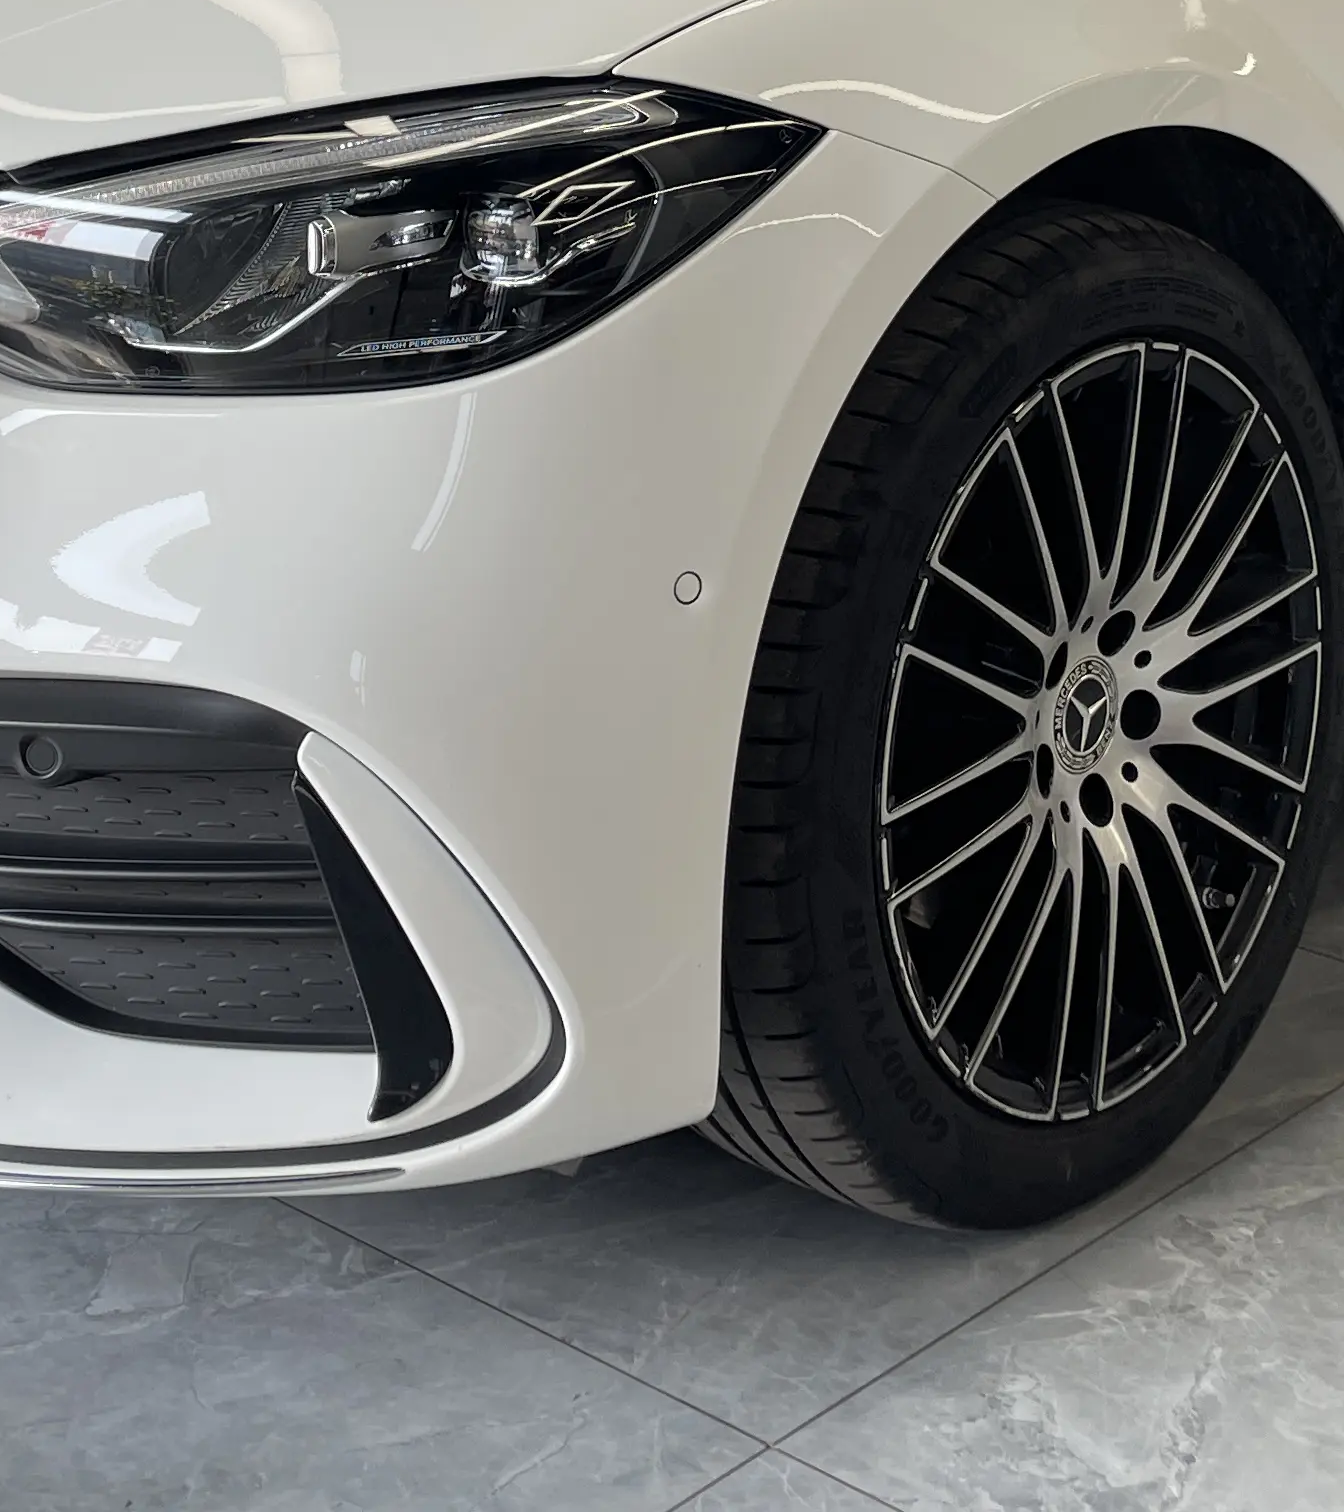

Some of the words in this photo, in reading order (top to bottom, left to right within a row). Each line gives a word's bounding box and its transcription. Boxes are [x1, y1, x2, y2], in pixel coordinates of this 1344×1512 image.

[360, 344, 379, 352] LED
[381, 342, 406, 350] HIGH
[408, 334, 482, 348] PERFORMANCE
[1055, 663, 1088, 730] MERCEDES
